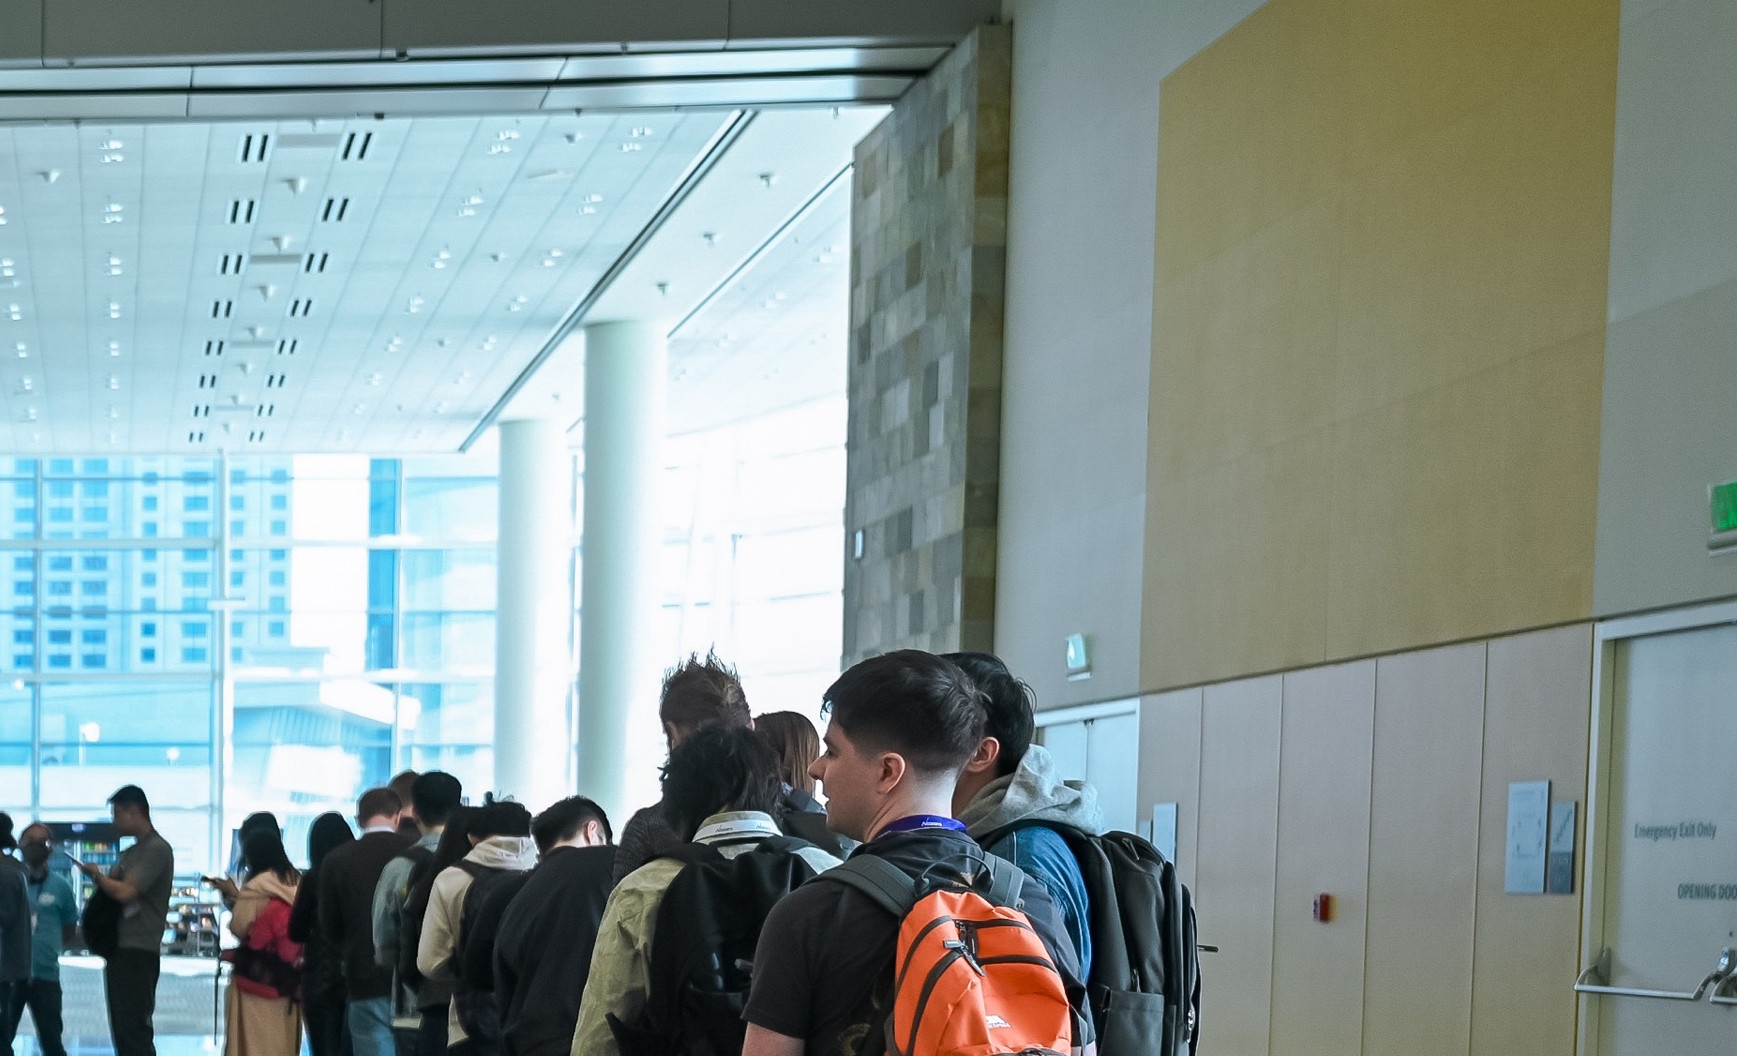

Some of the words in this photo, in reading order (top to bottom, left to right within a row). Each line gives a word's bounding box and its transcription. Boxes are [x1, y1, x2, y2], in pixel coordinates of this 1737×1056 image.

[1635, 824, 1677, 841] Emergency
[1680, 822, 1695, 838] Exit
[1697, 822, 1717, 840] Only
[1678, 883, 1716, 899] OPENING
